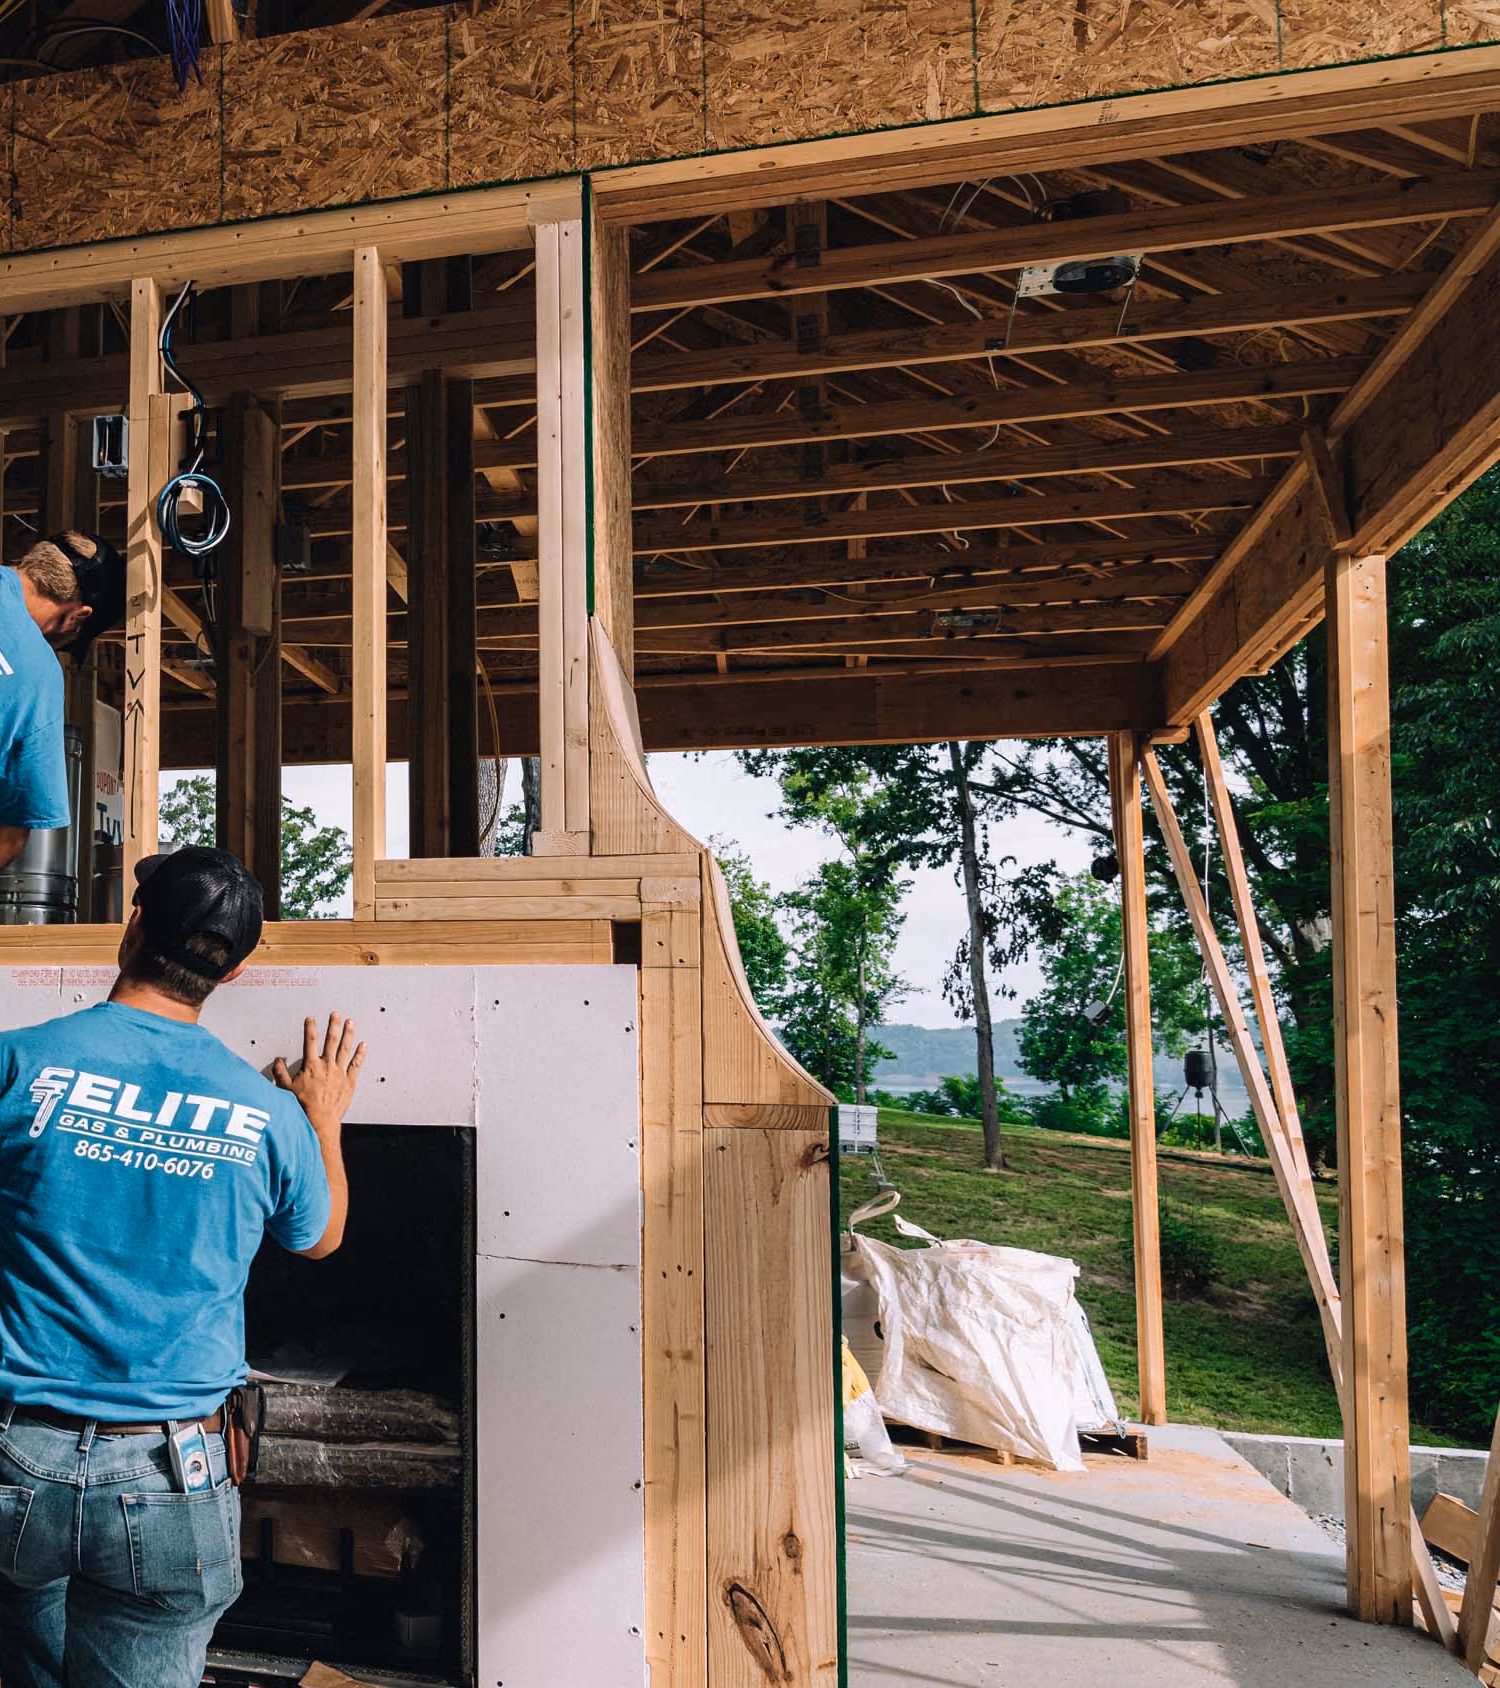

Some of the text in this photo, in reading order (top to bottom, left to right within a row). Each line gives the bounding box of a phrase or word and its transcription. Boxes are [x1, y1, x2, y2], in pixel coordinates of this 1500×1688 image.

[67, 1071, 271, 1143] ELITE
[58, 1114, 257, 1162] GAS & PLUMBING
[73, 1139, 215, 1180] 865-410-6076
